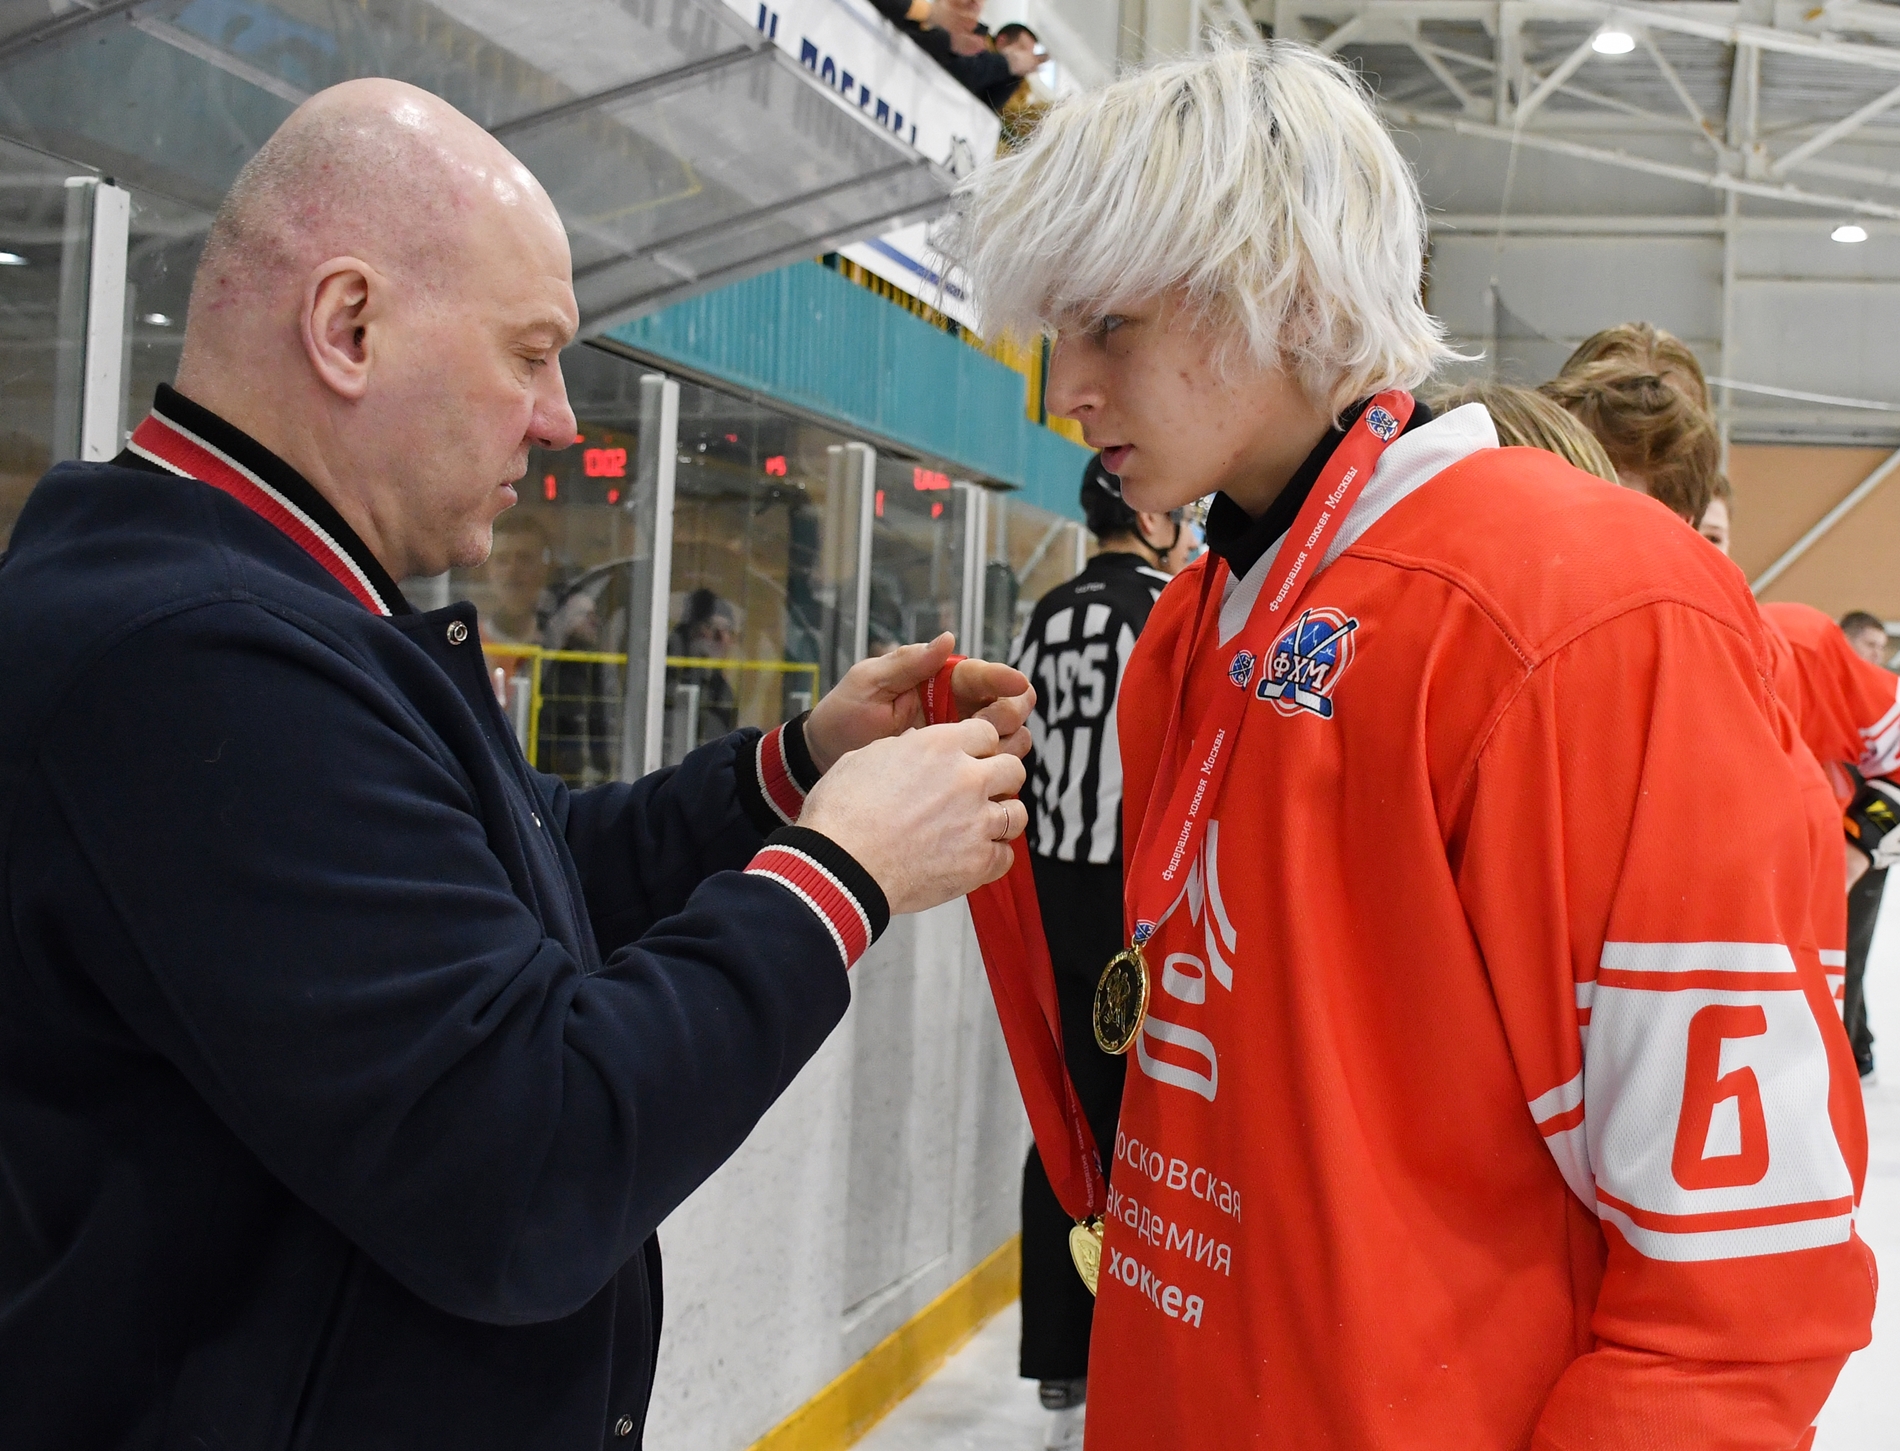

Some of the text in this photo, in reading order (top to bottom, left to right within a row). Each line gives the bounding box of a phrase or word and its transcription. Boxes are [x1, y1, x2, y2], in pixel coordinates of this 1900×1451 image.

[1269, 466, 1358, 612] Федерация хоккея Москвы
[1039, 643, 1109, 725] 195
[1273, 652, 1330, 690] ФХМ
[1162, 729, 1226, 881] Федерация хоккея Москвы
[1671, 1004, 1770, 1191] 6
[1114, 1118, 1242, 1224] осковская
[1106, 1183, 1232, 1277] академия
[1108, 1247, 1205, 1328] хоккея
